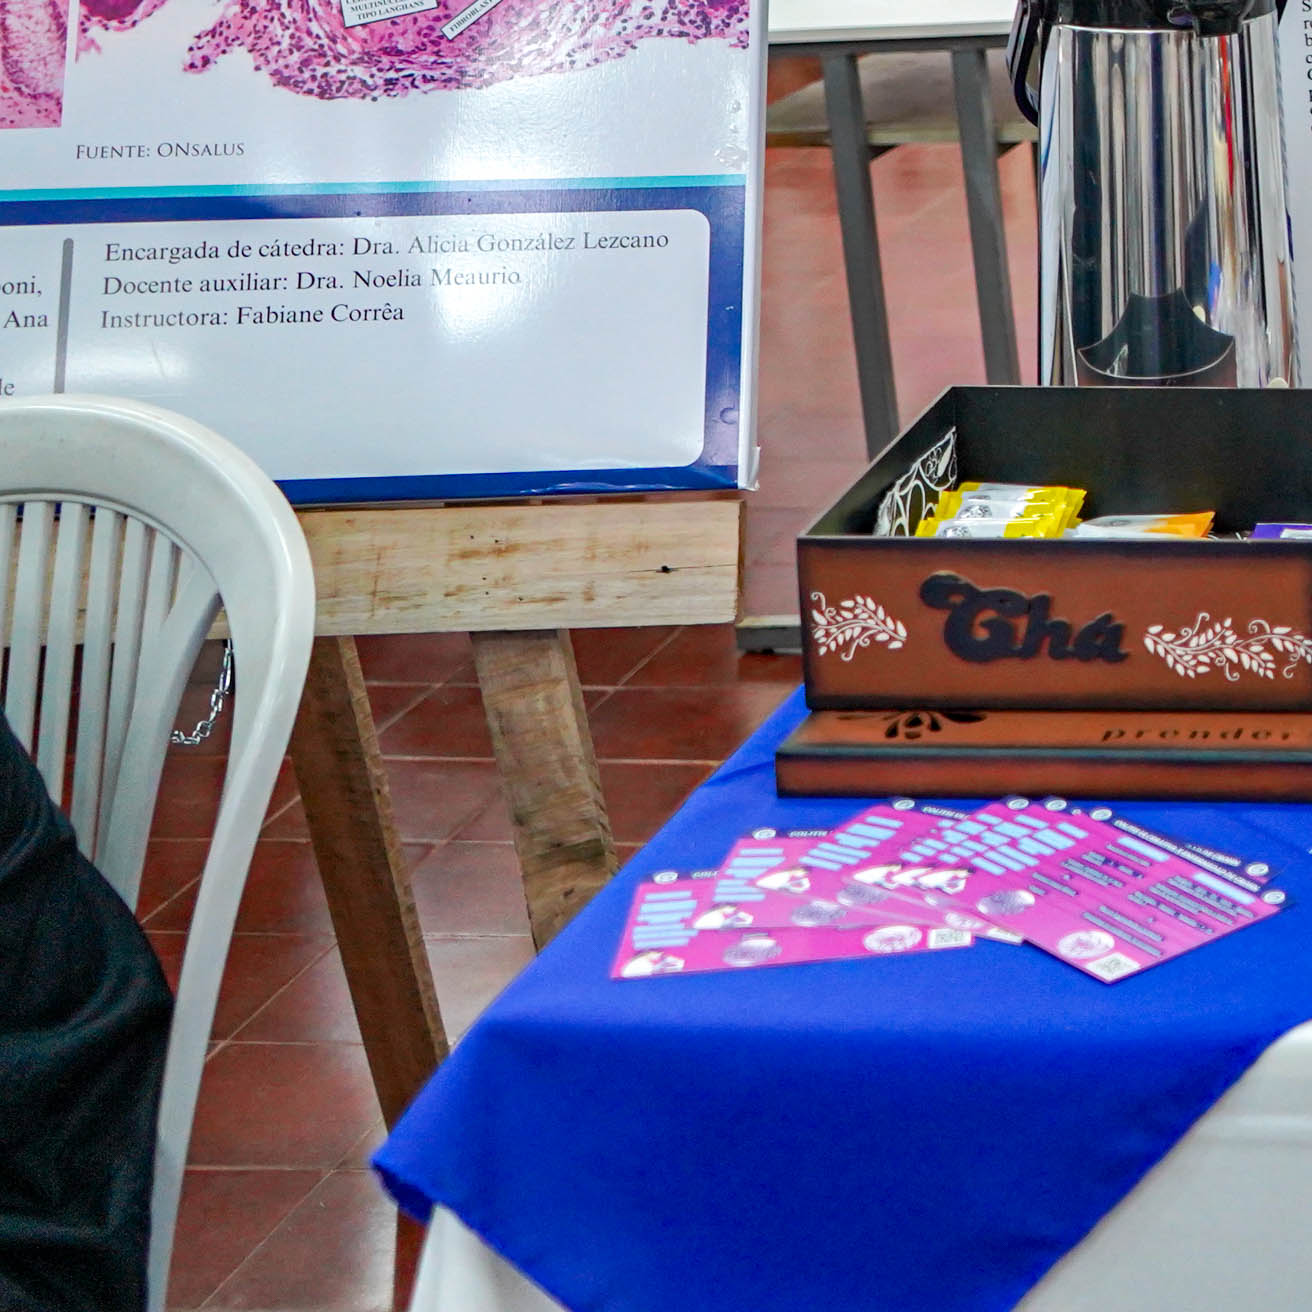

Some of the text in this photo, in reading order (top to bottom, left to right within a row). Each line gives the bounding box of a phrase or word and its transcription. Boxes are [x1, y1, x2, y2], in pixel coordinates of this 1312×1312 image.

[357, 11, 376, 21] TIPO
[105, 231, 670, 264] Encargada de cátedra: Dra. Alicia González Lezcano
[103, 267, 520, 295] Docente auxiliar: Dra. Noelia Meaurio
[3, 310, 49, 329] Ana
[100, 302, 405, 329] Instructora: Fabiane Corrêa
[919, 570, 1130, 665] Chá
